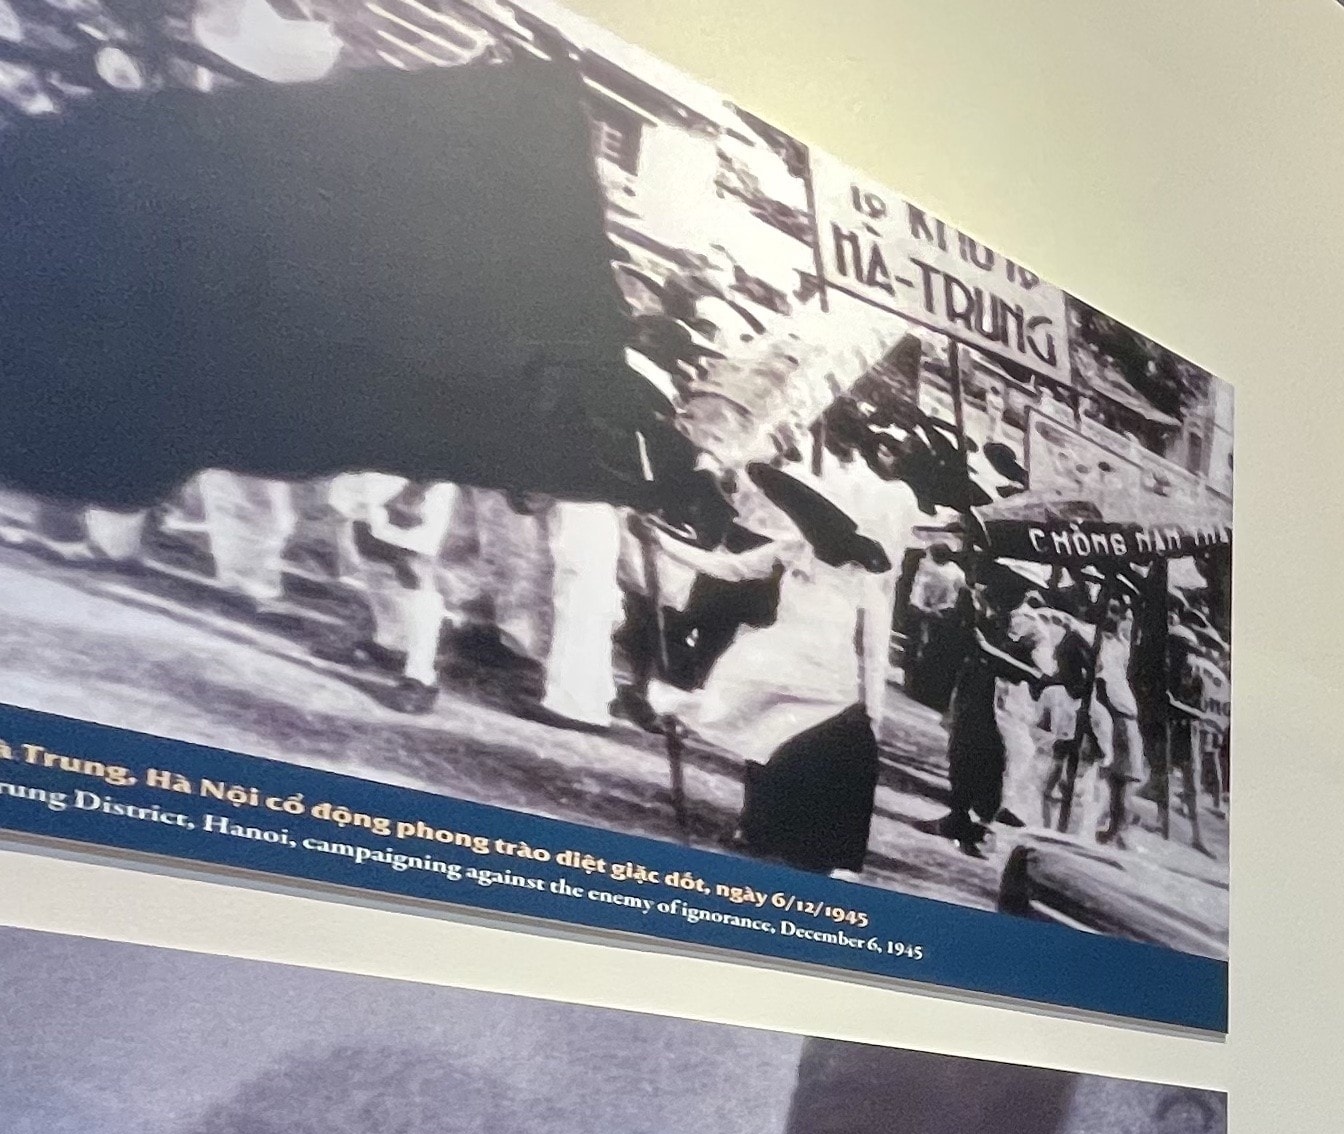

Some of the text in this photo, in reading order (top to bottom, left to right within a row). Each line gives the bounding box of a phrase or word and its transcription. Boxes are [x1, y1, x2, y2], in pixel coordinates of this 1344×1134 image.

[21, 743, 138, 786] Trung,
[146, 767, 192, 795] Hà
[200, 778, 259, 808] Nội
[265, 792, 306, 815] cổ
[311, 803, 391, 836] động
[396, 820, 489, 855] phong
[494, 839, 551, 863] trào
[556, 850, 606, 876] diệt
[611, 861, 660, 885] giặc
[664, 871, 710, 896] dốt,
[716, 883, 768, 908] ngày
[772, 892, 869, 928] 6/12/1945
[74, 789, 195, 830] District,
[203, 813, 297, 849] Hanoi,
[302, 837, 462, 881] campaigning
[465, 864, 546, 891] against
[550, 878, 584, 899] the
[587, 890, 654, 915] enemy
[657, 900, 682, 915] of
[682, 903, 776, 935] ignorance,
[781, 920, 866, 949] December
[887, 941, 923, 960] 1945
